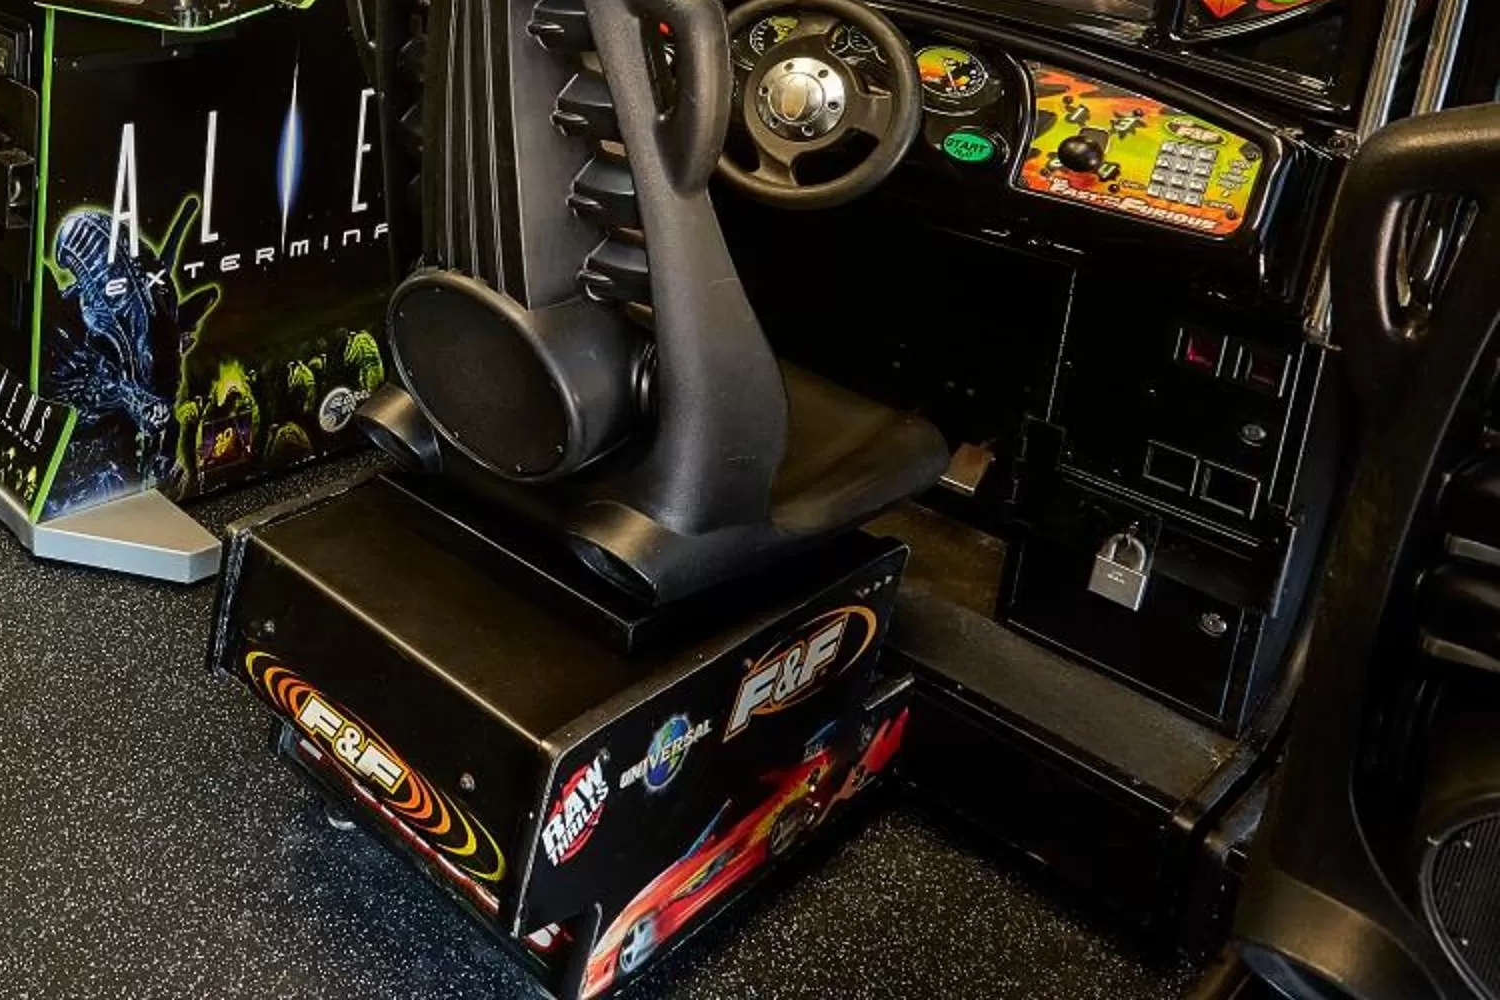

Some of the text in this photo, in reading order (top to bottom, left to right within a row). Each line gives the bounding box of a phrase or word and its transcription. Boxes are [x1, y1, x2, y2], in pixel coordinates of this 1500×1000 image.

[108, 75, 376, 264] ALIE
[945, 138, 989, 153] START
[105, 222, 388, 296] EXTERMINA
[727, 616, 848, 738] F&F
[299, 695, 404, 788] F&F
[619, 719, 713, 789] UNIVERSAL
[542, 756, 606, 853] RAW
